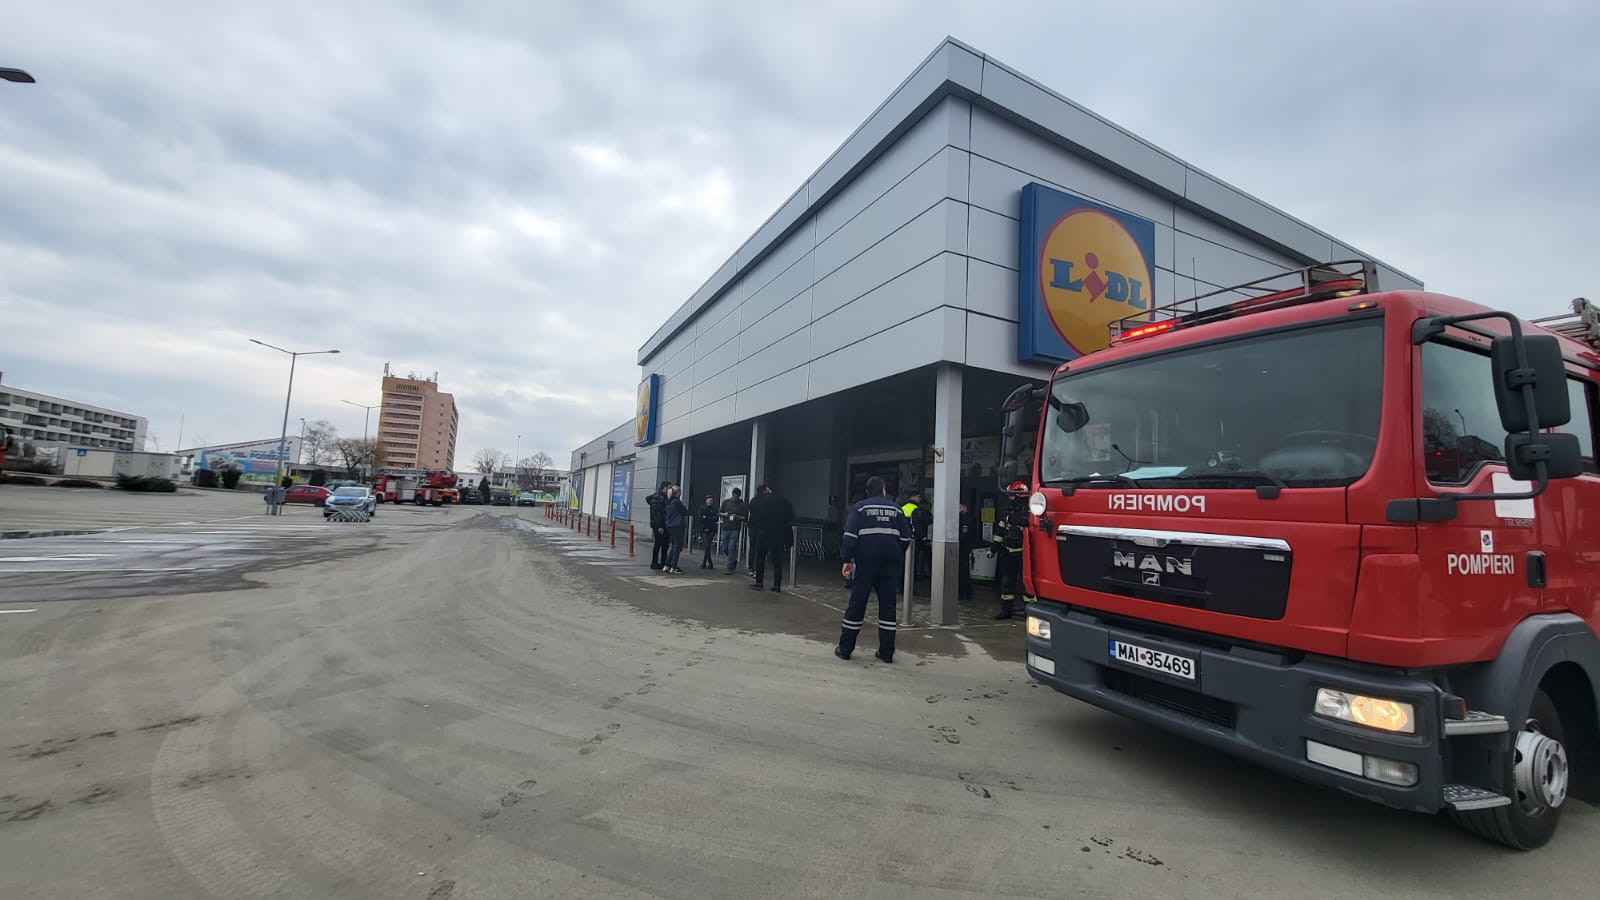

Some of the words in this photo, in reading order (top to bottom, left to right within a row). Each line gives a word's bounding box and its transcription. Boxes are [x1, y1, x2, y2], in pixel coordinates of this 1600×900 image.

[1113, 551, 1193, 576] MAN
[1447, 553, 1515, 575] POMPIERI
[1118, 643, 1139, 663] MAI
[1145, 650, 1191, 676] 35469
